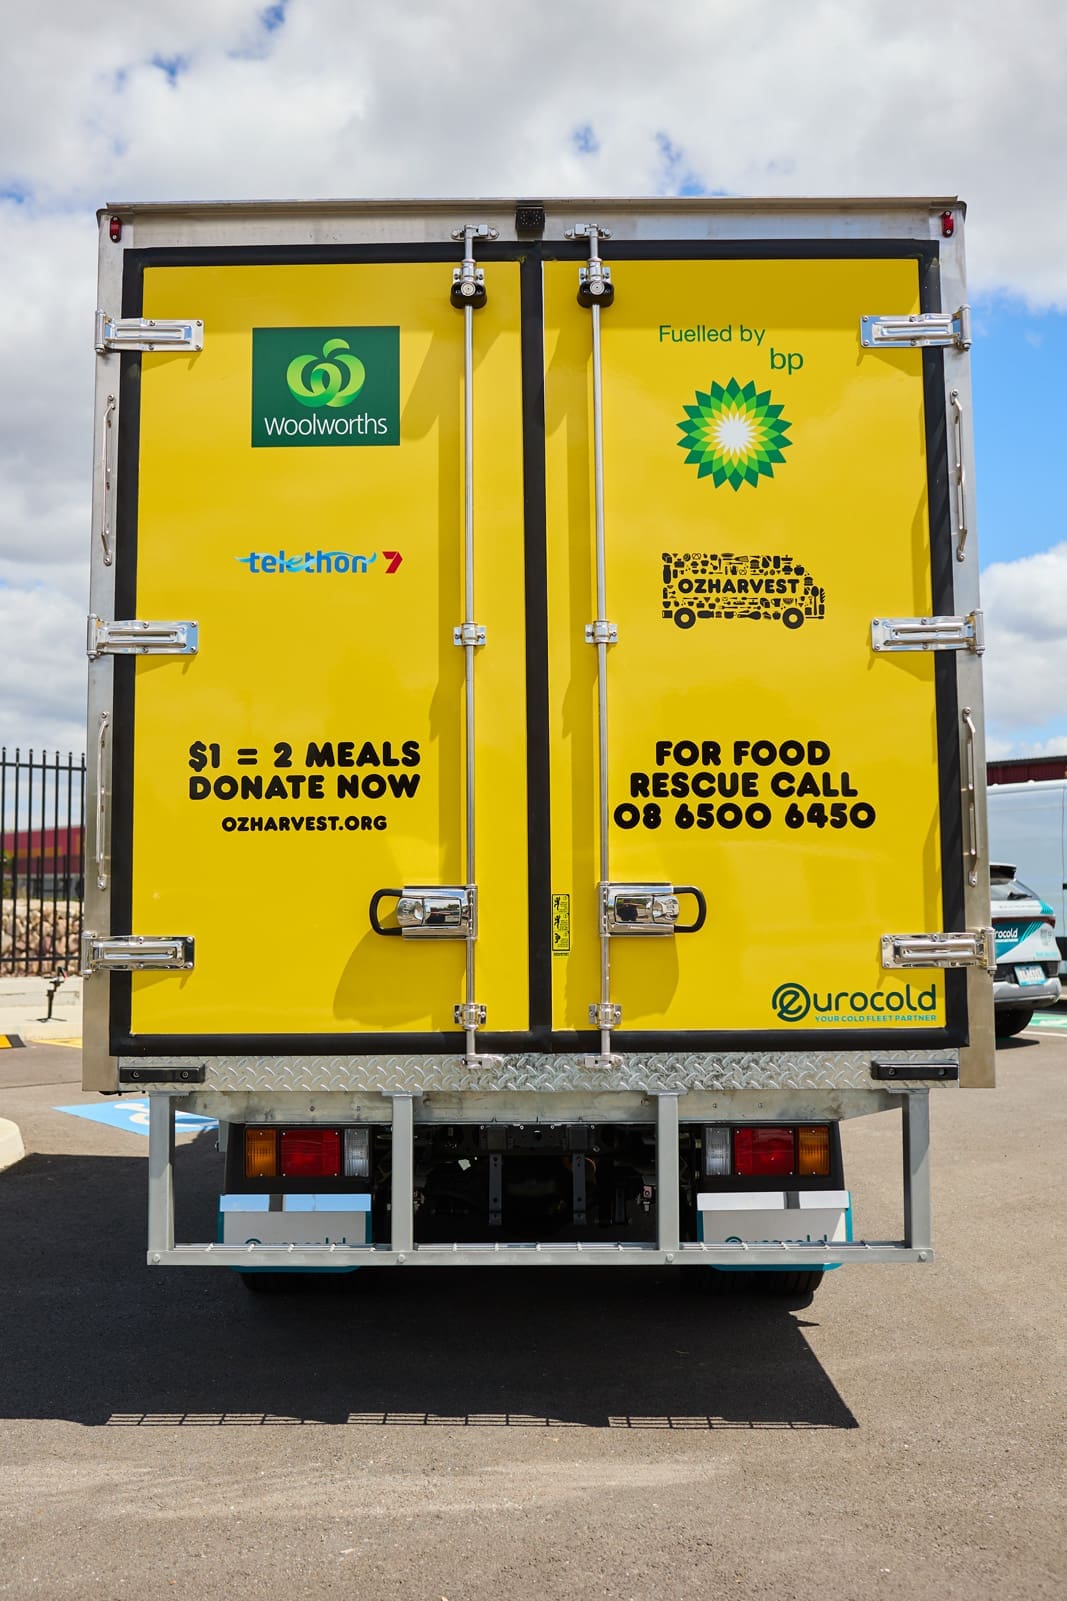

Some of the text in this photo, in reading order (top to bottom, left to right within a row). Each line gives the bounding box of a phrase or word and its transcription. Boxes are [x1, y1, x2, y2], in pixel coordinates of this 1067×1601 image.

[659, 324, 766, 346] Fuelled by
[770, 347, 804, 375] bp
[264, 412, 388, 436] Woolworths
[249, 550, 368, 574] telethon
[678, 578, 800, 594] OZHARVEST
[189, 741, 221, 772] $1
[274, 742, 293, 768] 2
[305, 741, 421, 767] MEALS
[656, 740, 831, 766] FOR FOOD
[189, 774, 421, 800] DONATE NOW
[630, 772, 859, 798] RESCUE CALL
[222, 816, 387, 832] OZHARVEST.ORG
[613, 802, 876, 830] 08 6500 6450
[772, 982, 936, 1022] eurocold
